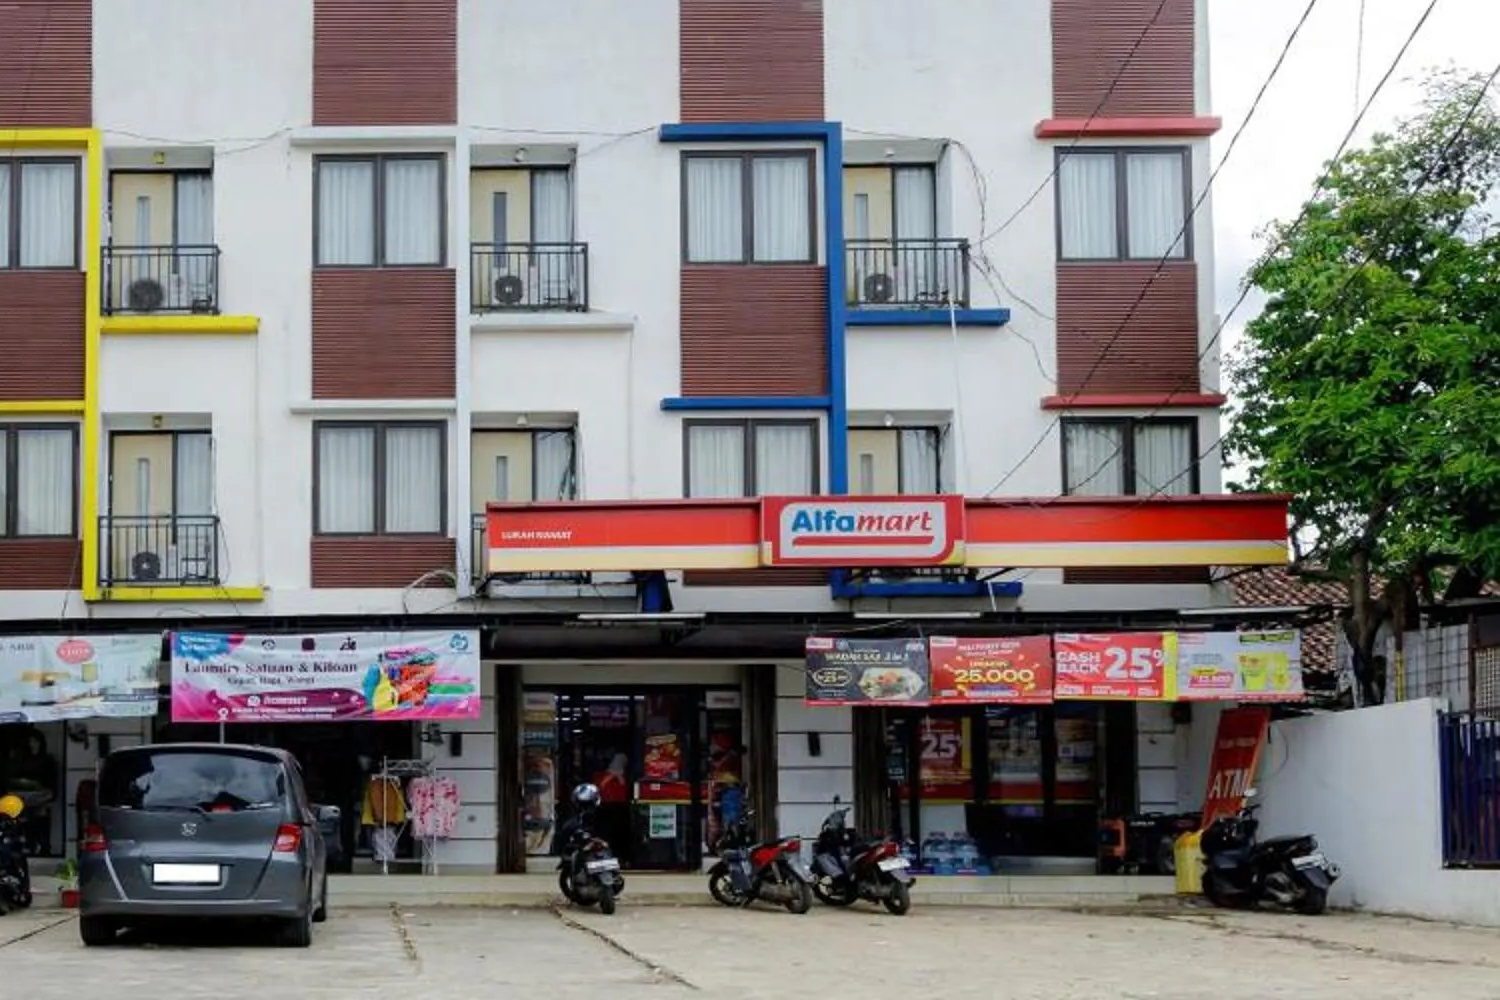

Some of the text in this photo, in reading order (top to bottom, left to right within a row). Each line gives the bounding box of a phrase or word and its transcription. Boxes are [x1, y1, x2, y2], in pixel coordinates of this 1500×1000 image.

[791, 509, 933, 532] Alfamart
[1056, 651, 1101, 662] CASH
[185, 661, 357, 674] Laundry Satuan & Kiloan
[1056, 662, 1101, 673] BACK
[954, 669, 1034, 683] 25.000
